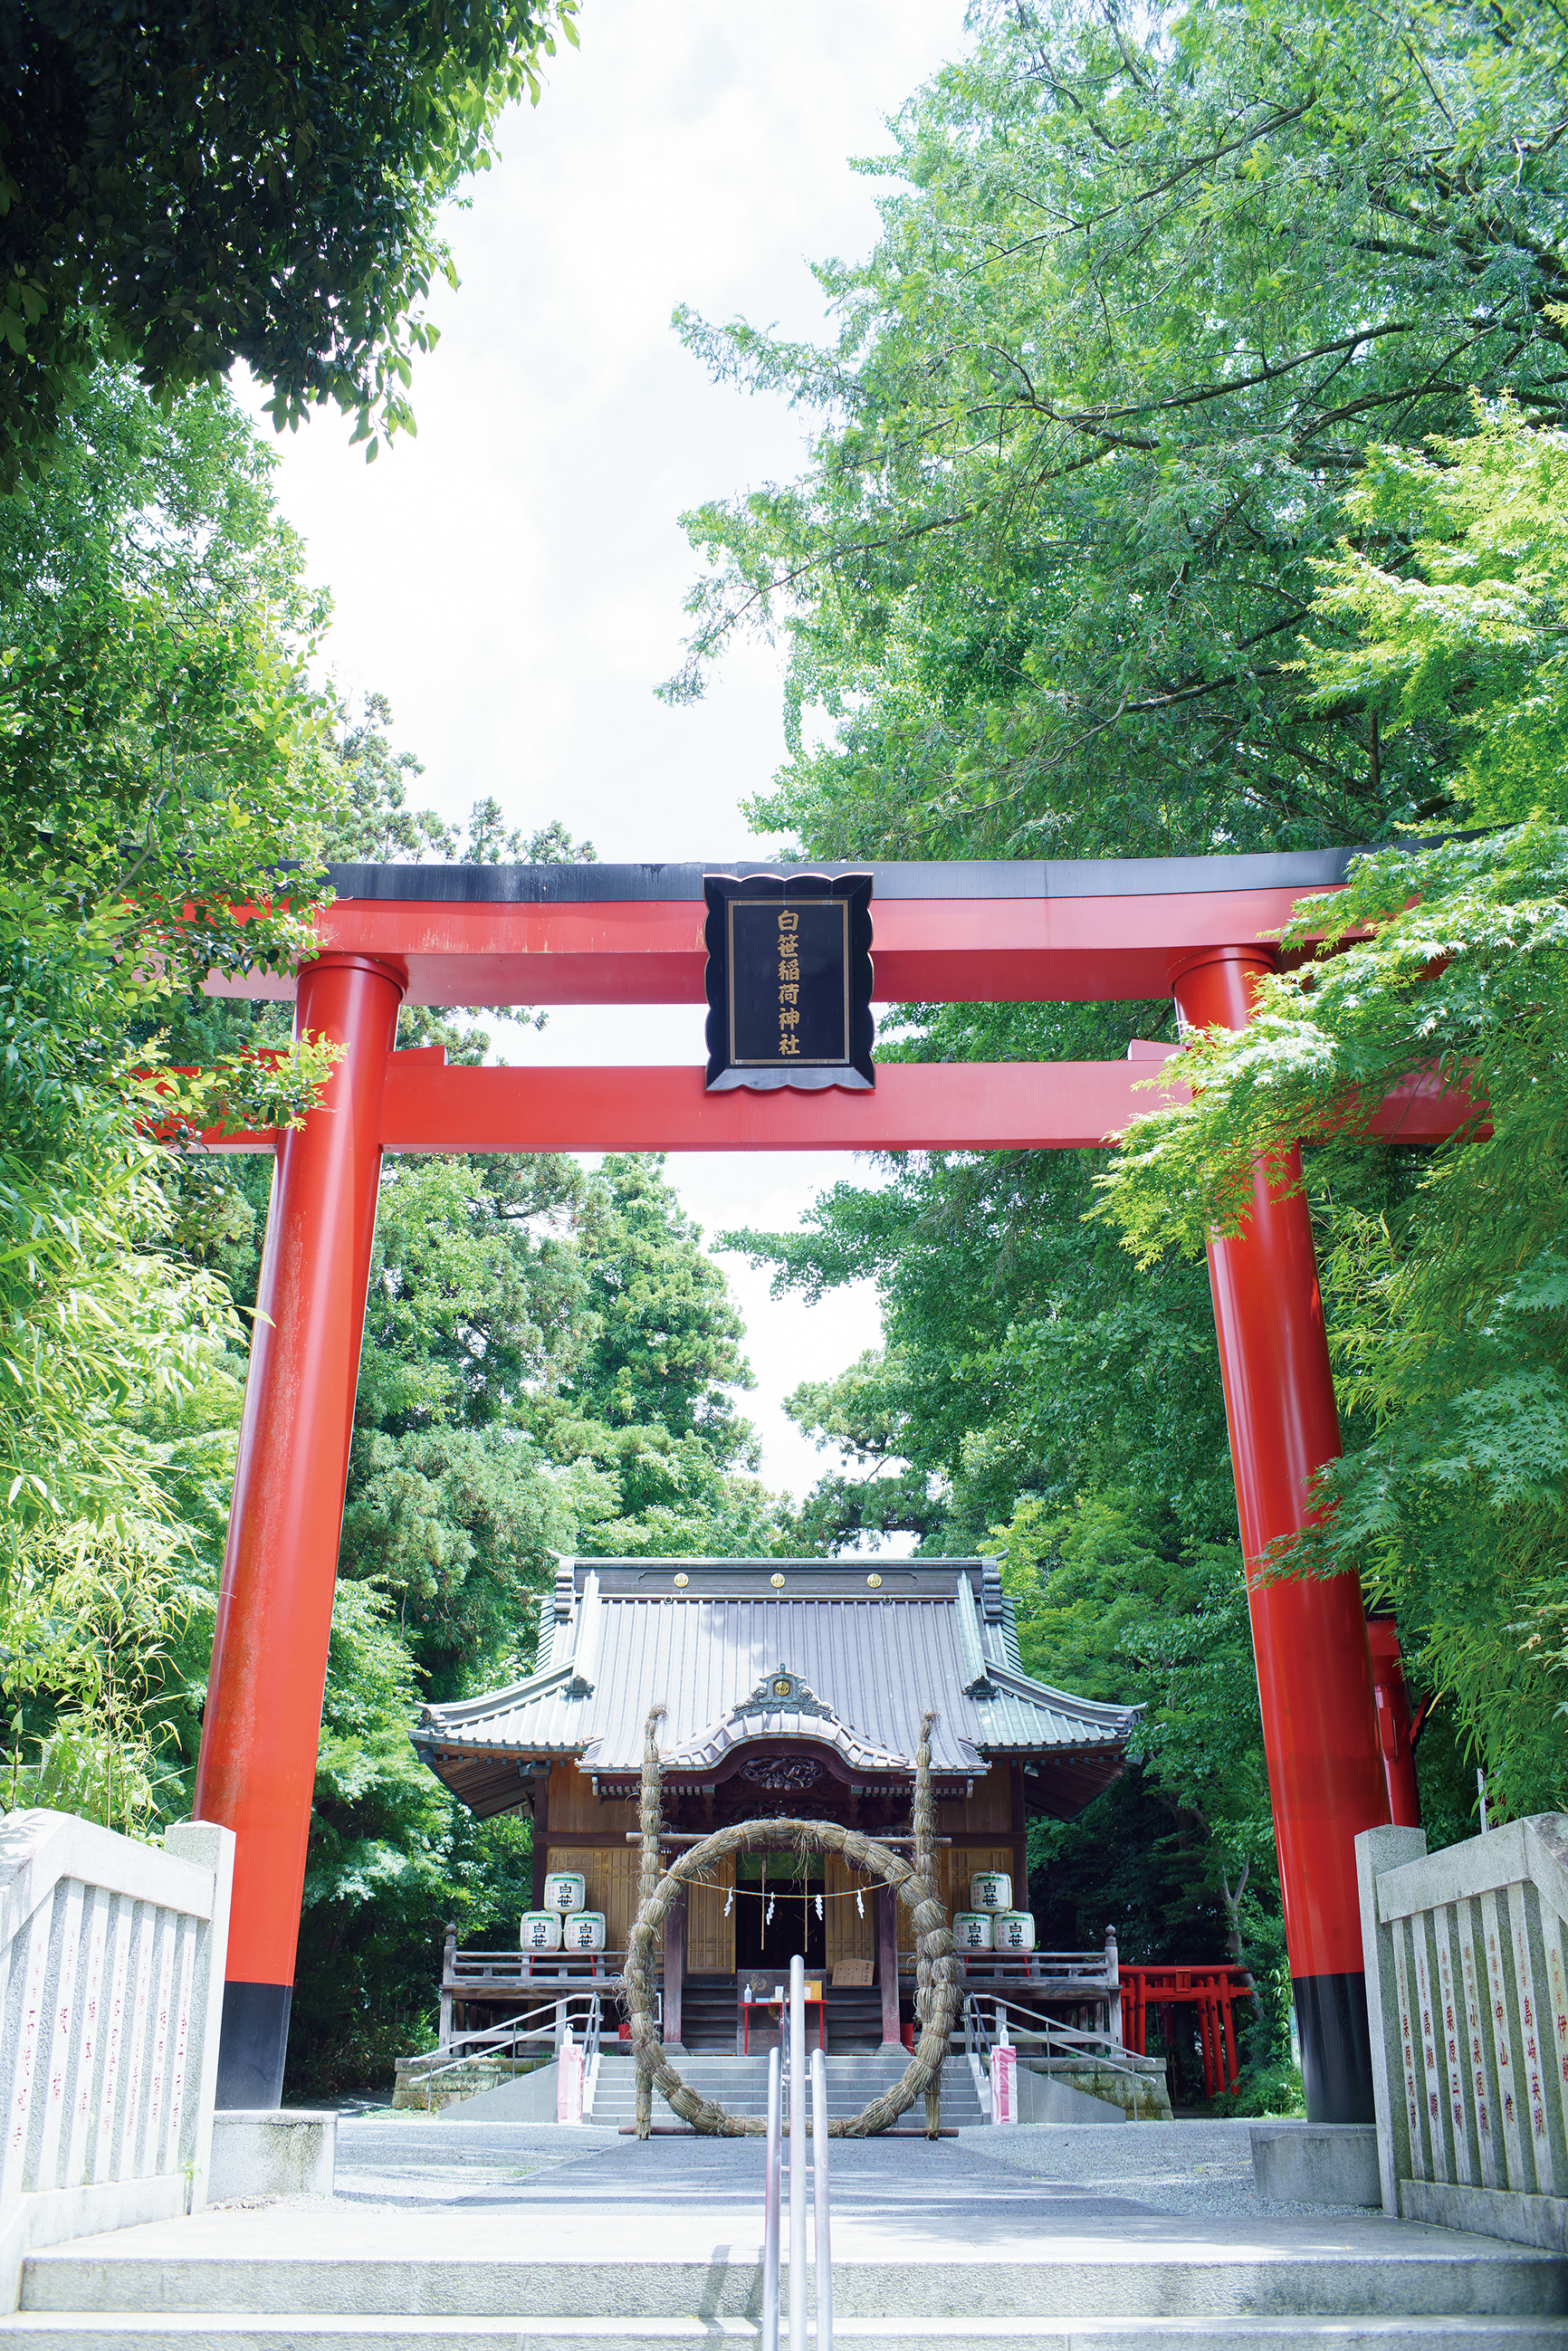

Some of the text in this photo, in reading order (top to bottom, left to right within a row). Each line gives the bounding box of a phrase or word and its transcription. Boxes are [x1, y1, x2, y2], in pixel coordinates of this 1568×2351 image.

[777, 910, 801, 1056] 白笹稲荷神社
[557, 1882, 573, 1907] 白笹
[981, 1881, 999, 1907] 白笹
[531, 1922, 547, 1947] 白笹
[578, 1922, 593, 1947] 白笹
[967, 1921, 983, 1947] 白笹
[1008, 1921, 1024, 1947] 白笹
